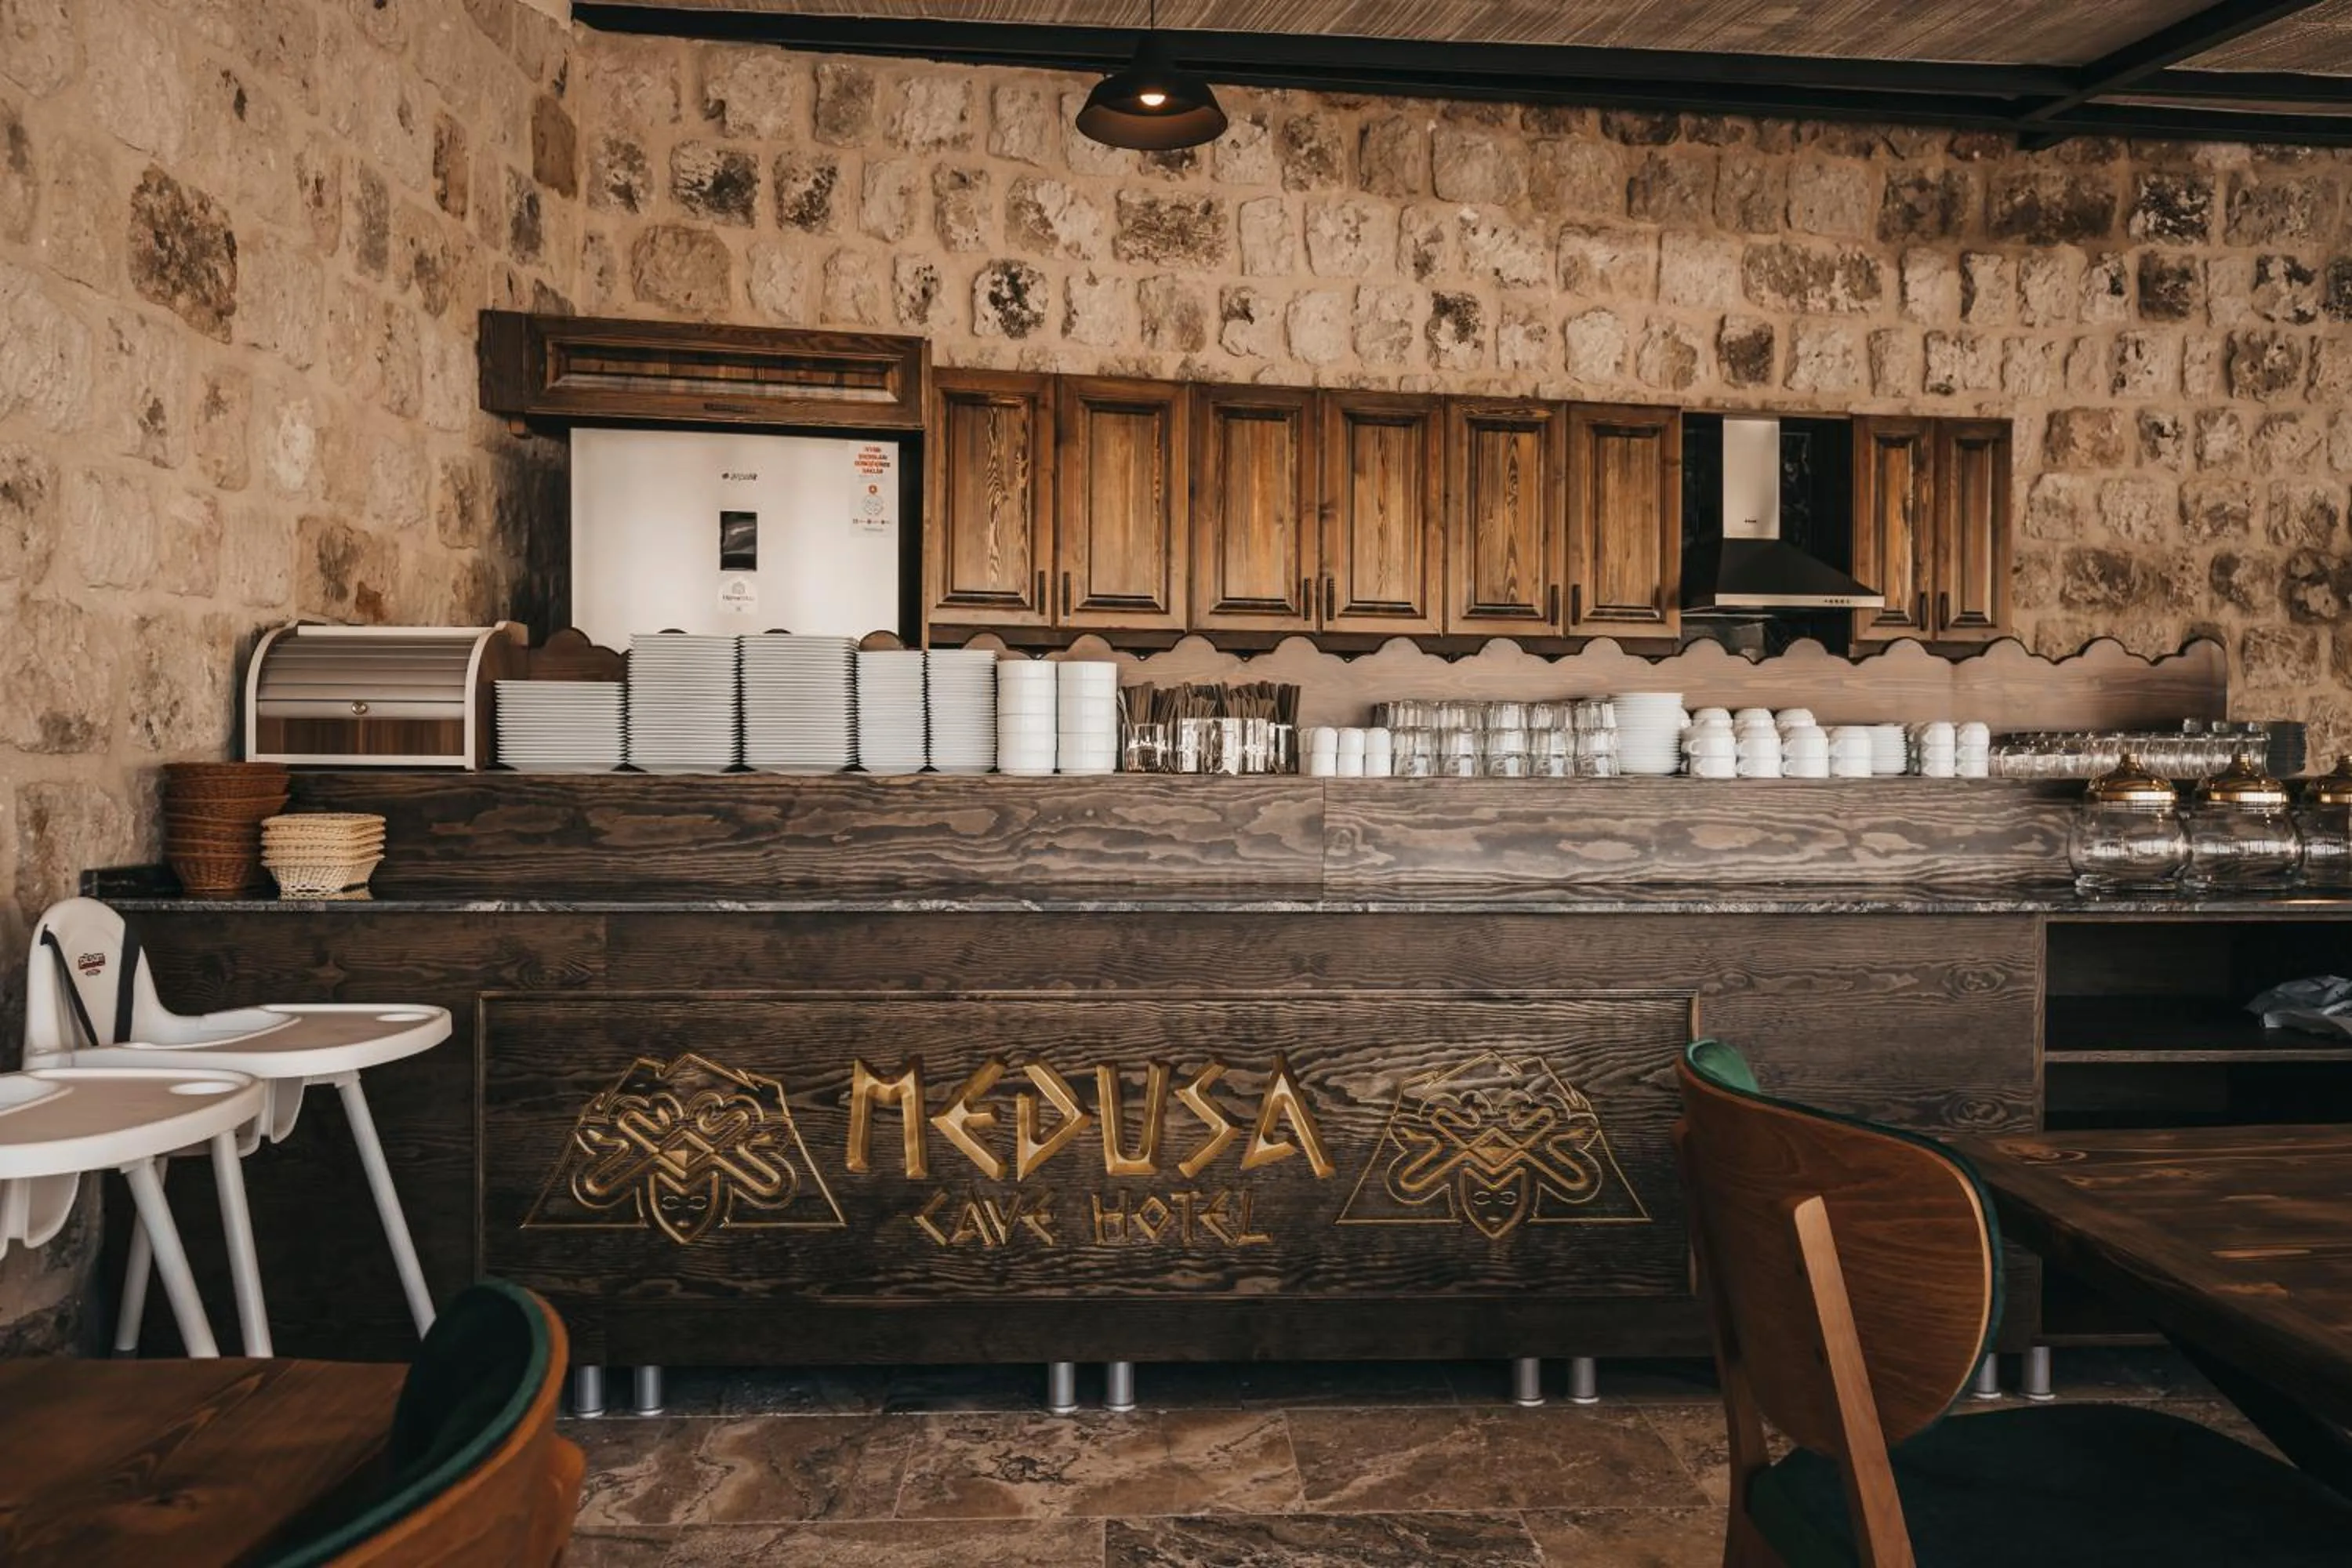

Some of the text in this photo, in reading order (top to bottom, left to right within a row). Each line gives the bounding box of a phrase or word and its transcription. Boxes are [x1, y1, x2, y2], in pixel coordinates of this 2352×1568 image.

[846, 1051, 1335, 1181] MEDUSA
[913, 1185, 1273, 1248] CAVE HOTEL
